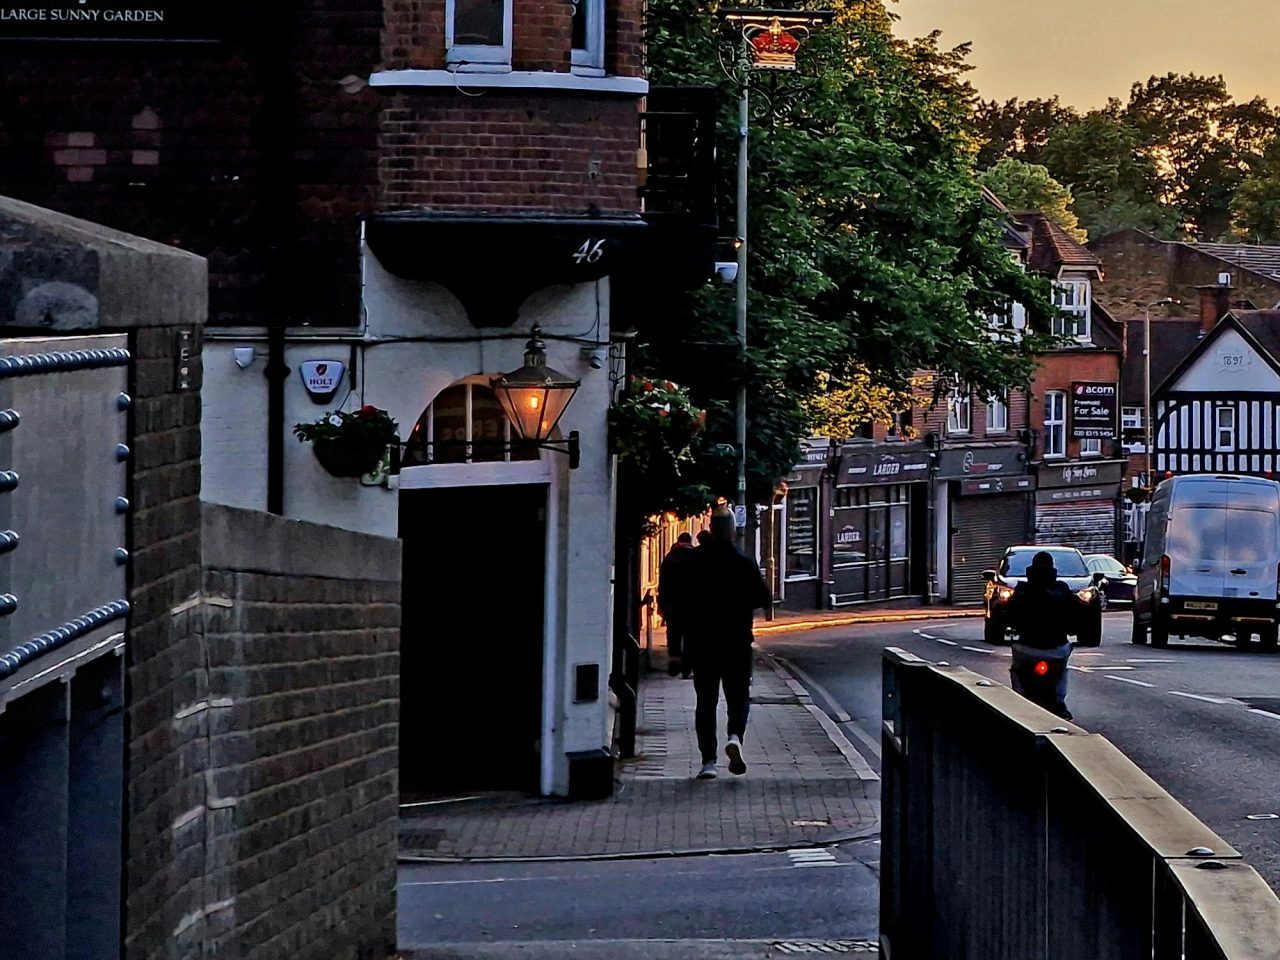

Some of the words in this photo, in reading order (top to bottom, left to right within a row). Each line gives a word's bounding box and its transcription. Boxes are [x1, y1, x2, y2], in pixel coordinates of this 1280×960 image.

[1, 9, 47, 20] LARGE
[50, 9, 100, 21] SUNNY
[103, 10, 164, 22] GARDEN
[572, 238, 606, 264] 46
[309, 378, 333, 386] HOLT
[1085, 386, 1114, 394] acorn
[1074, 406, 1089, 414] For
[1091, 407, 1109, 415] Sale
[873, 463, 900, 476] LARDER
[837, 531, 860, 543] LARDER
